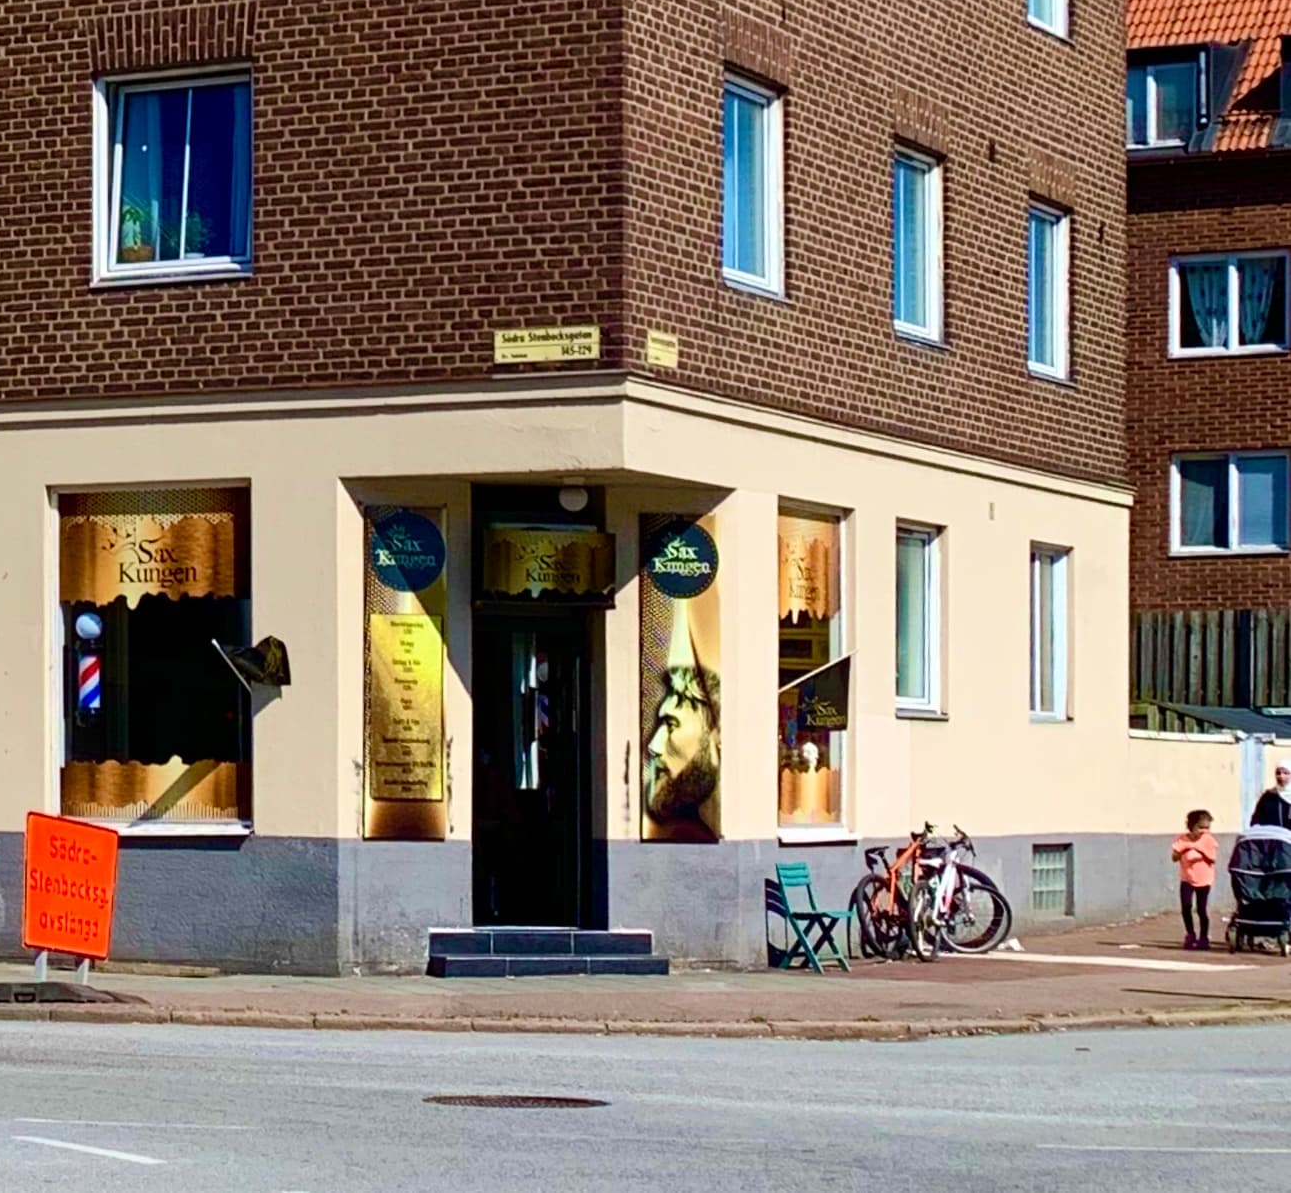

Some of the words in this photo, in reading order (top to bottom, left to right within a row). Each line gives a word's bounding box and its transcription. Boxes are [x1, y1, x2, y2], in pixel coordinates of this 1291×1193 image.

[137, 534, 179, 564] Sax
[389, 533, 422, 551] Sax
[664, 539, 699, 559] Sax
[374, 548, 437, 569] Kungen
[651, 557, 712, 577] Kungen
[118, 563, 197, 588] Kungen
[49, 834, 98, 866] Södra-
[29, 867, 109, 910] Stenbocksg.
[39, 910, 99, 942] avstängd
